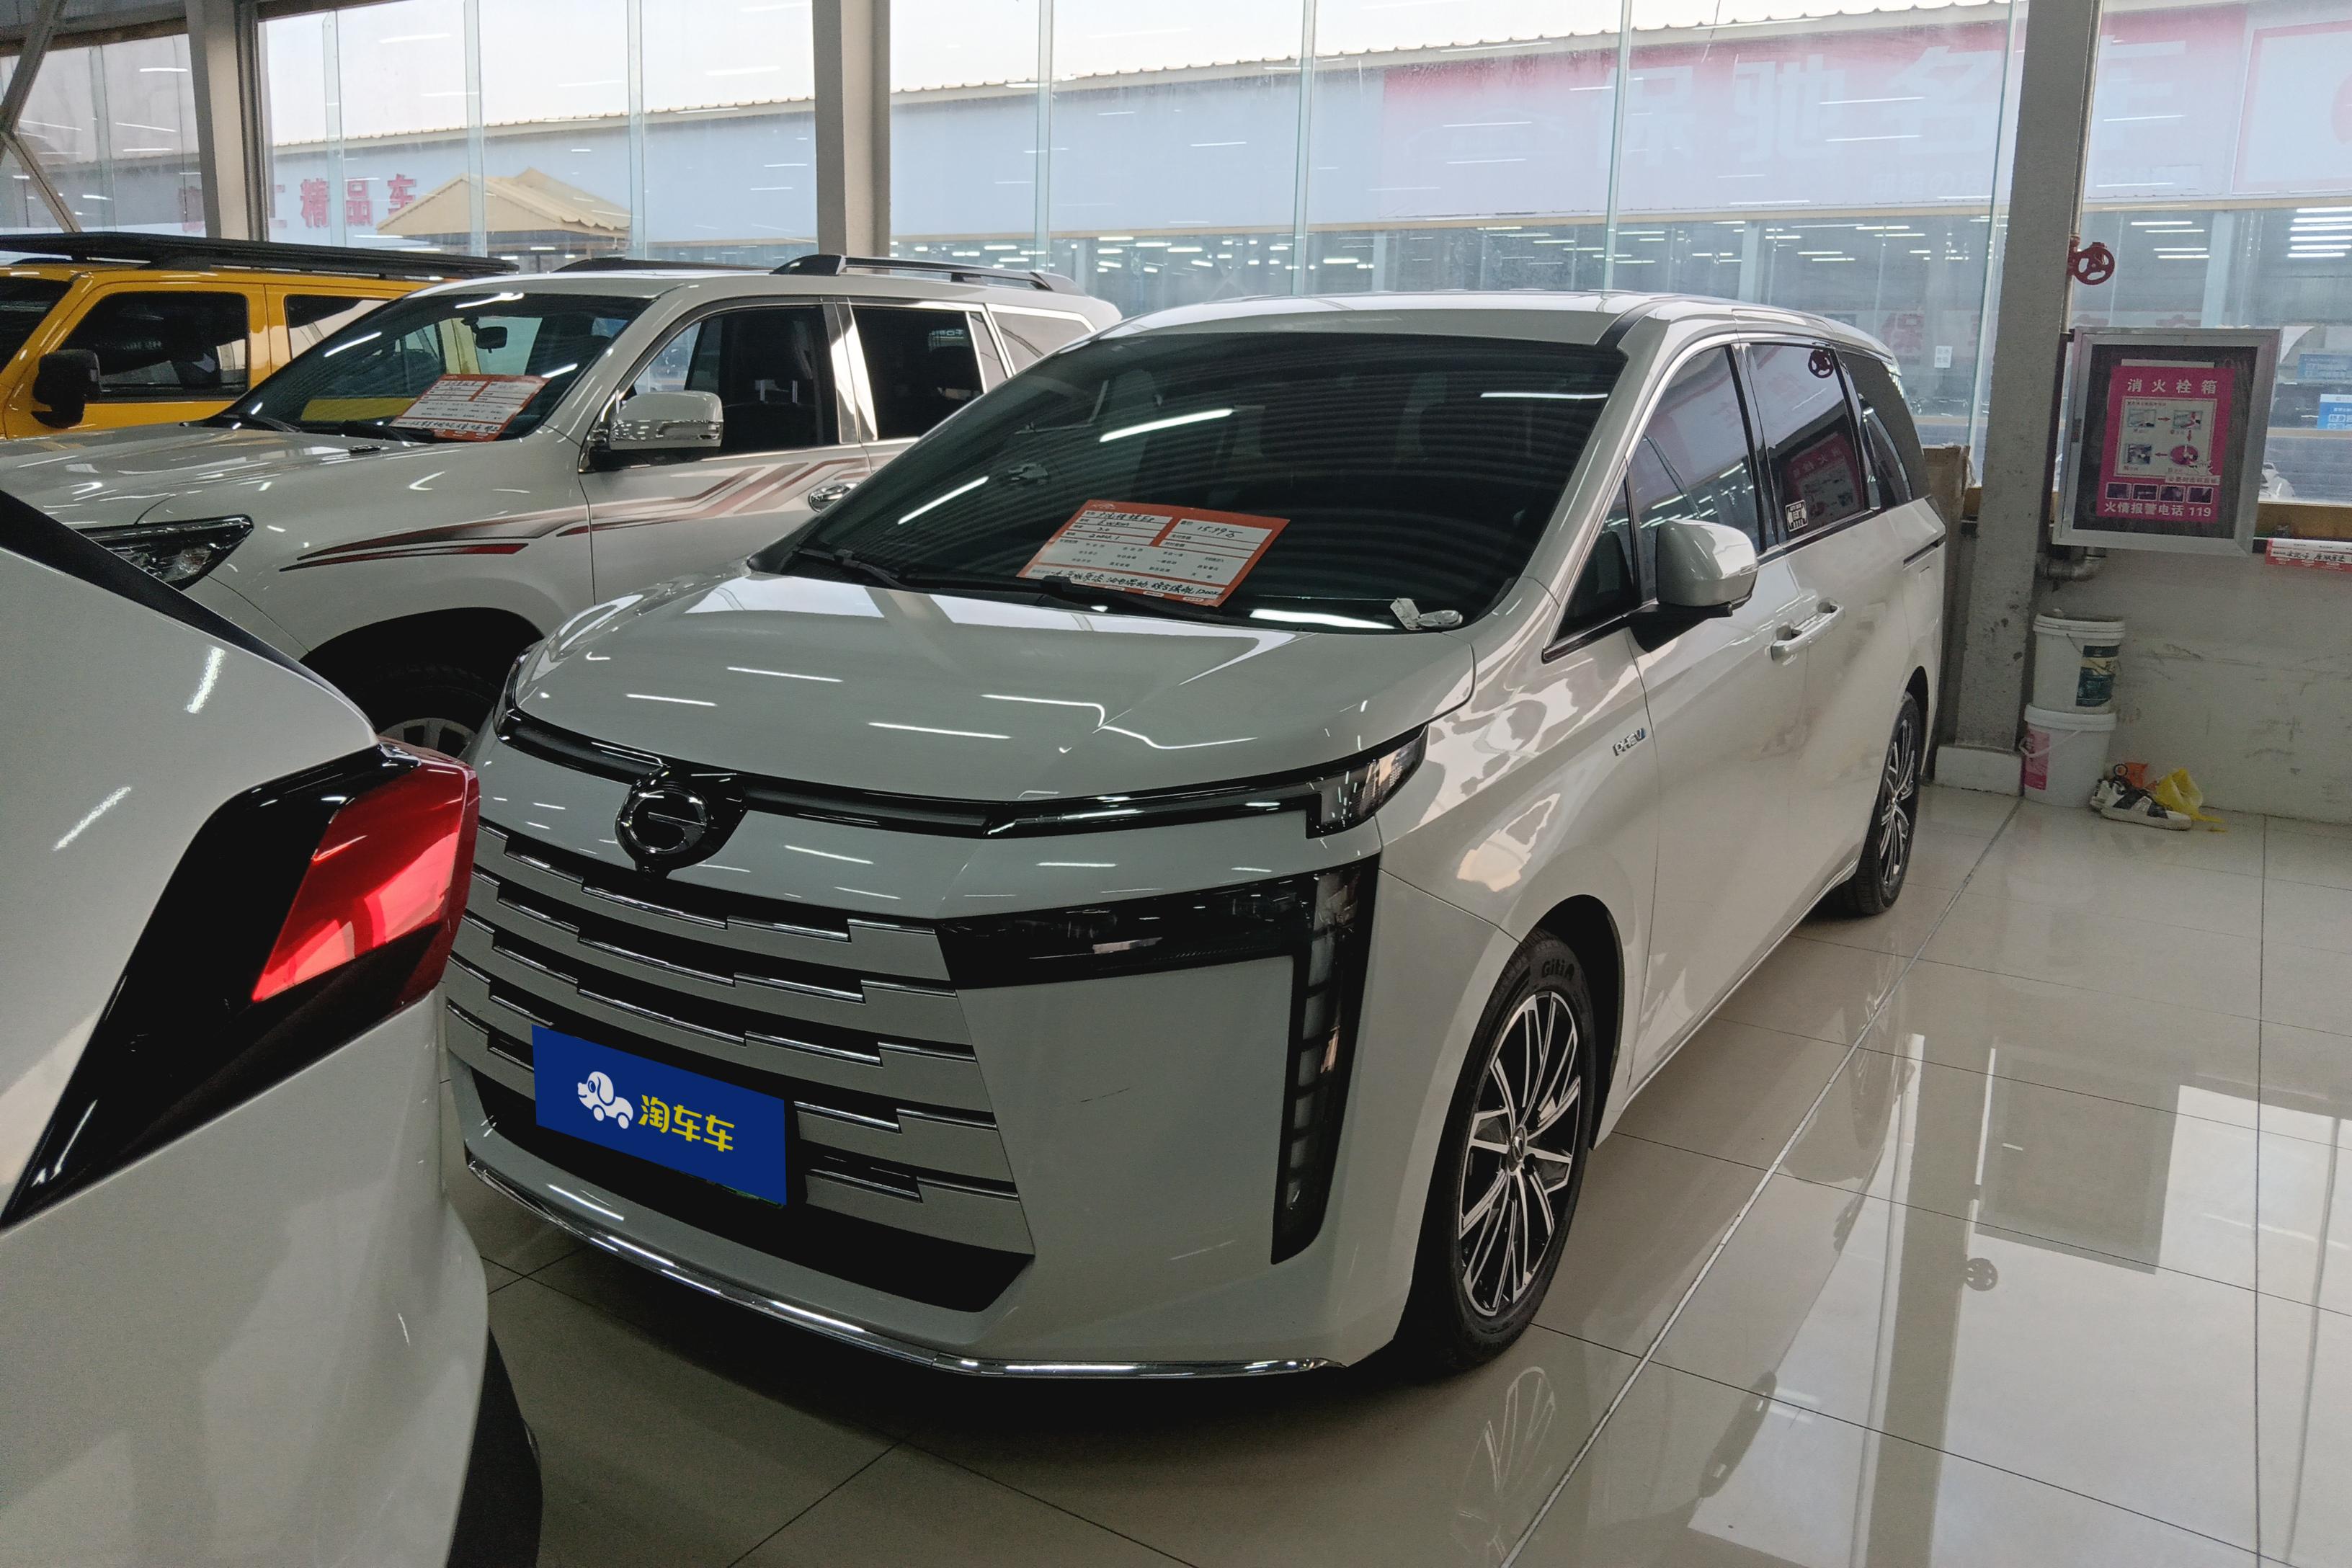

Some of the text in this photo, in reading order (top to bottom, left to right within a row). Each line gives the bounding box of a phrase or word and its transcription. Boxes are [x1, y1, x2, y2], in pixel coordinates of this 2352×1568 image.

[2127, 378, 2217, 394] 消火栓箱
[2104, 502, 2211, 517] 火情报警电话 119
